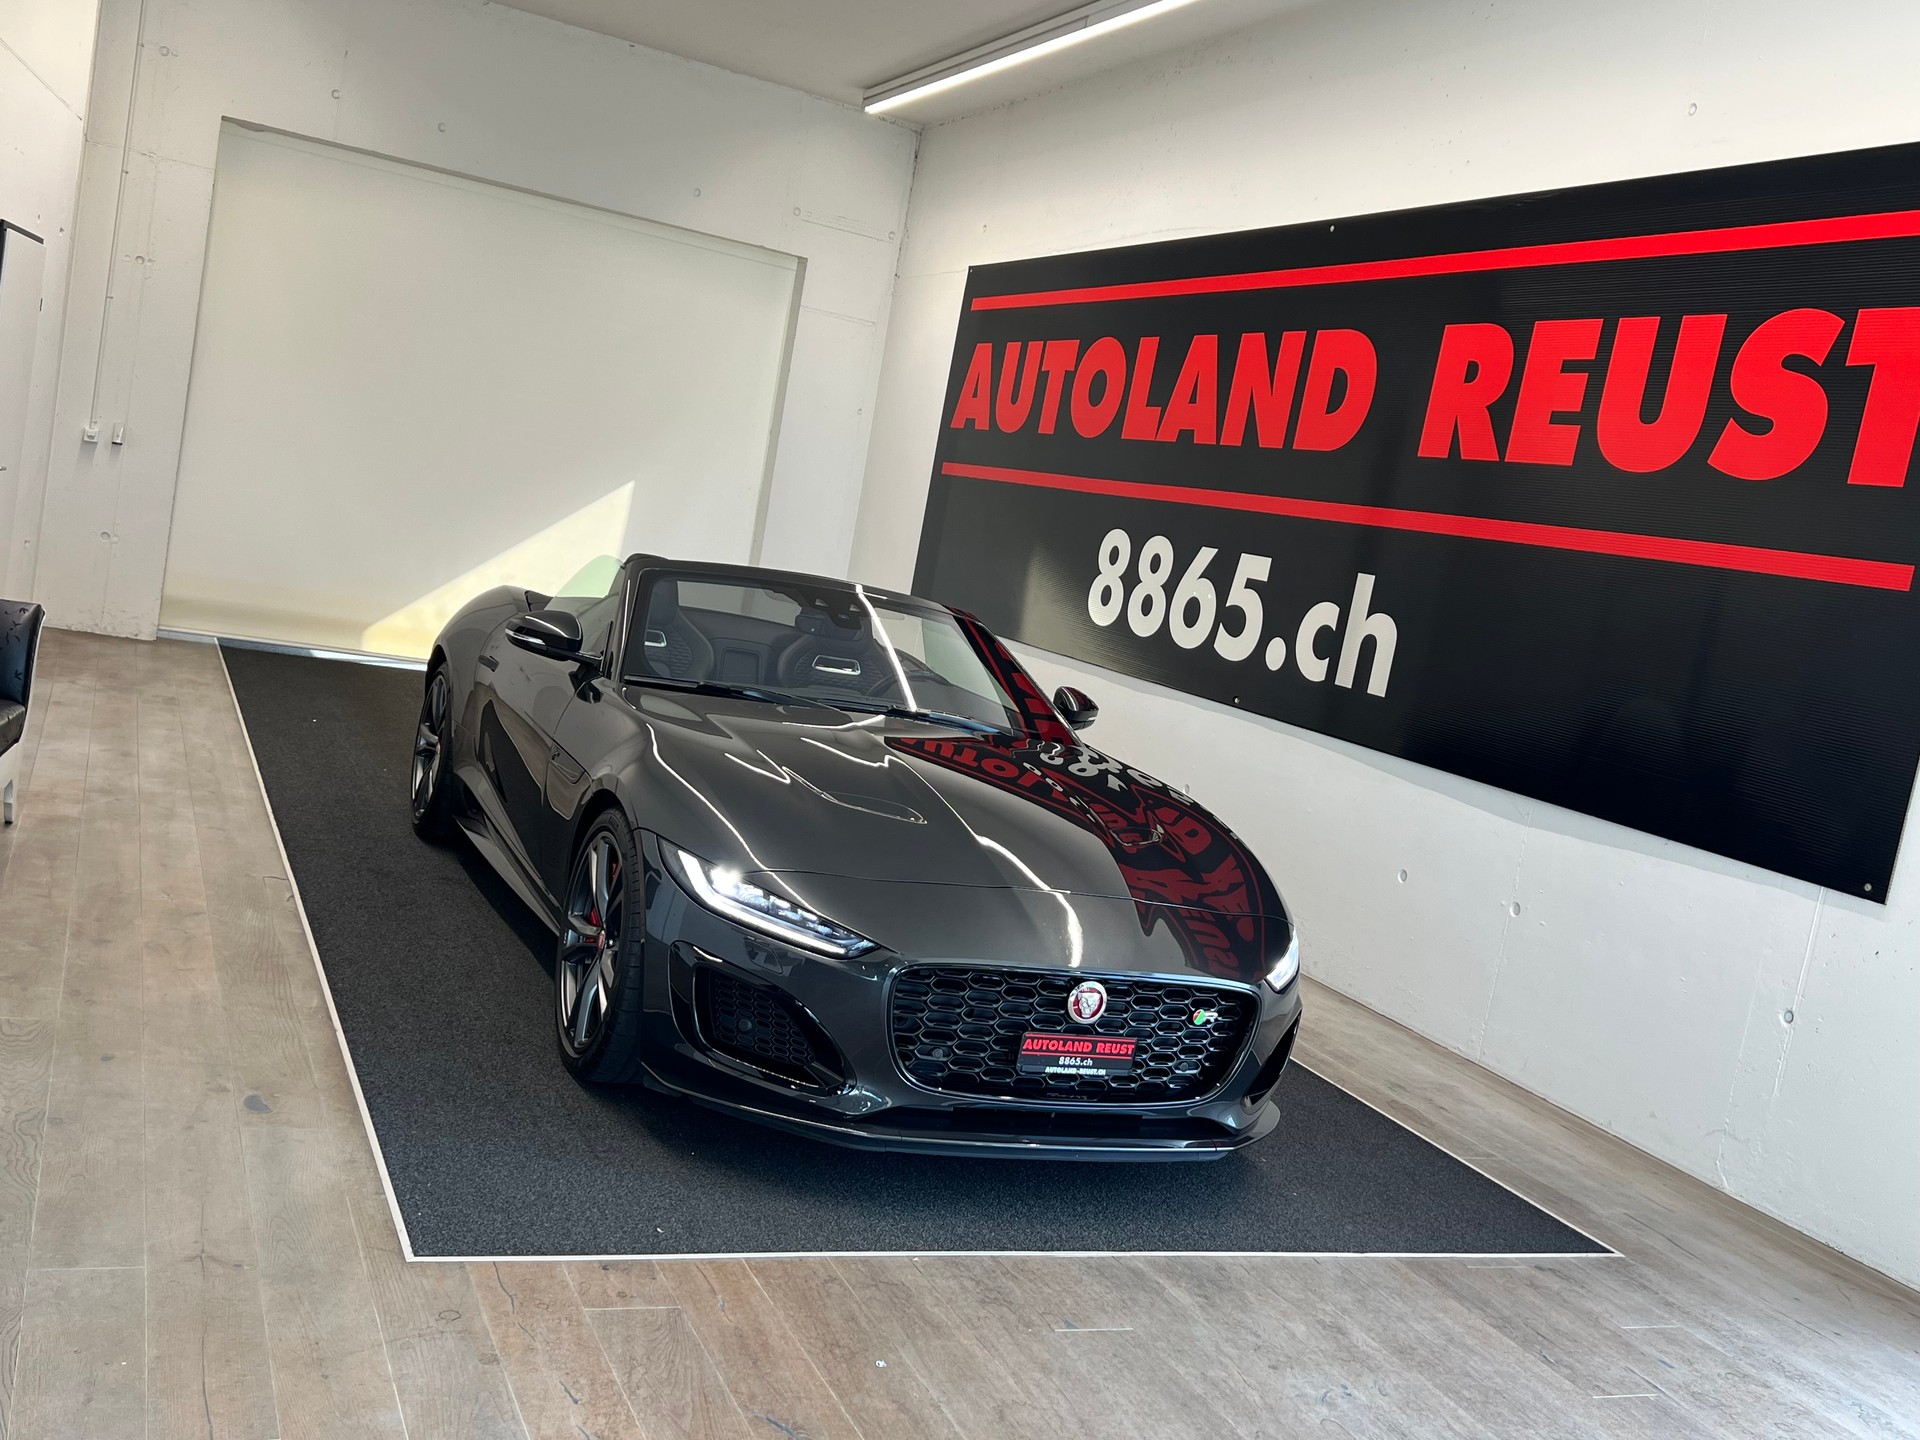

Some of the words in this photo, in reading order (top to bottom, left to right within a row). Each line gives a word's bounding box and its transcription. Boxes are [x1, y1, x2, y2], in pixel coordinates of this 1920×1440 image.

[951, 328, 1378, 452] AUTOLAND
[1417, 306, 1920, 488] REUST
[1087, 528, 1398, 698] 8865.ch
[1022, 1038, 1093, 1053] AUTOLAND
[1096, 1043, 1135, 1054] REUST
[1058, 1056, 1093, 1066] 8865.ch
